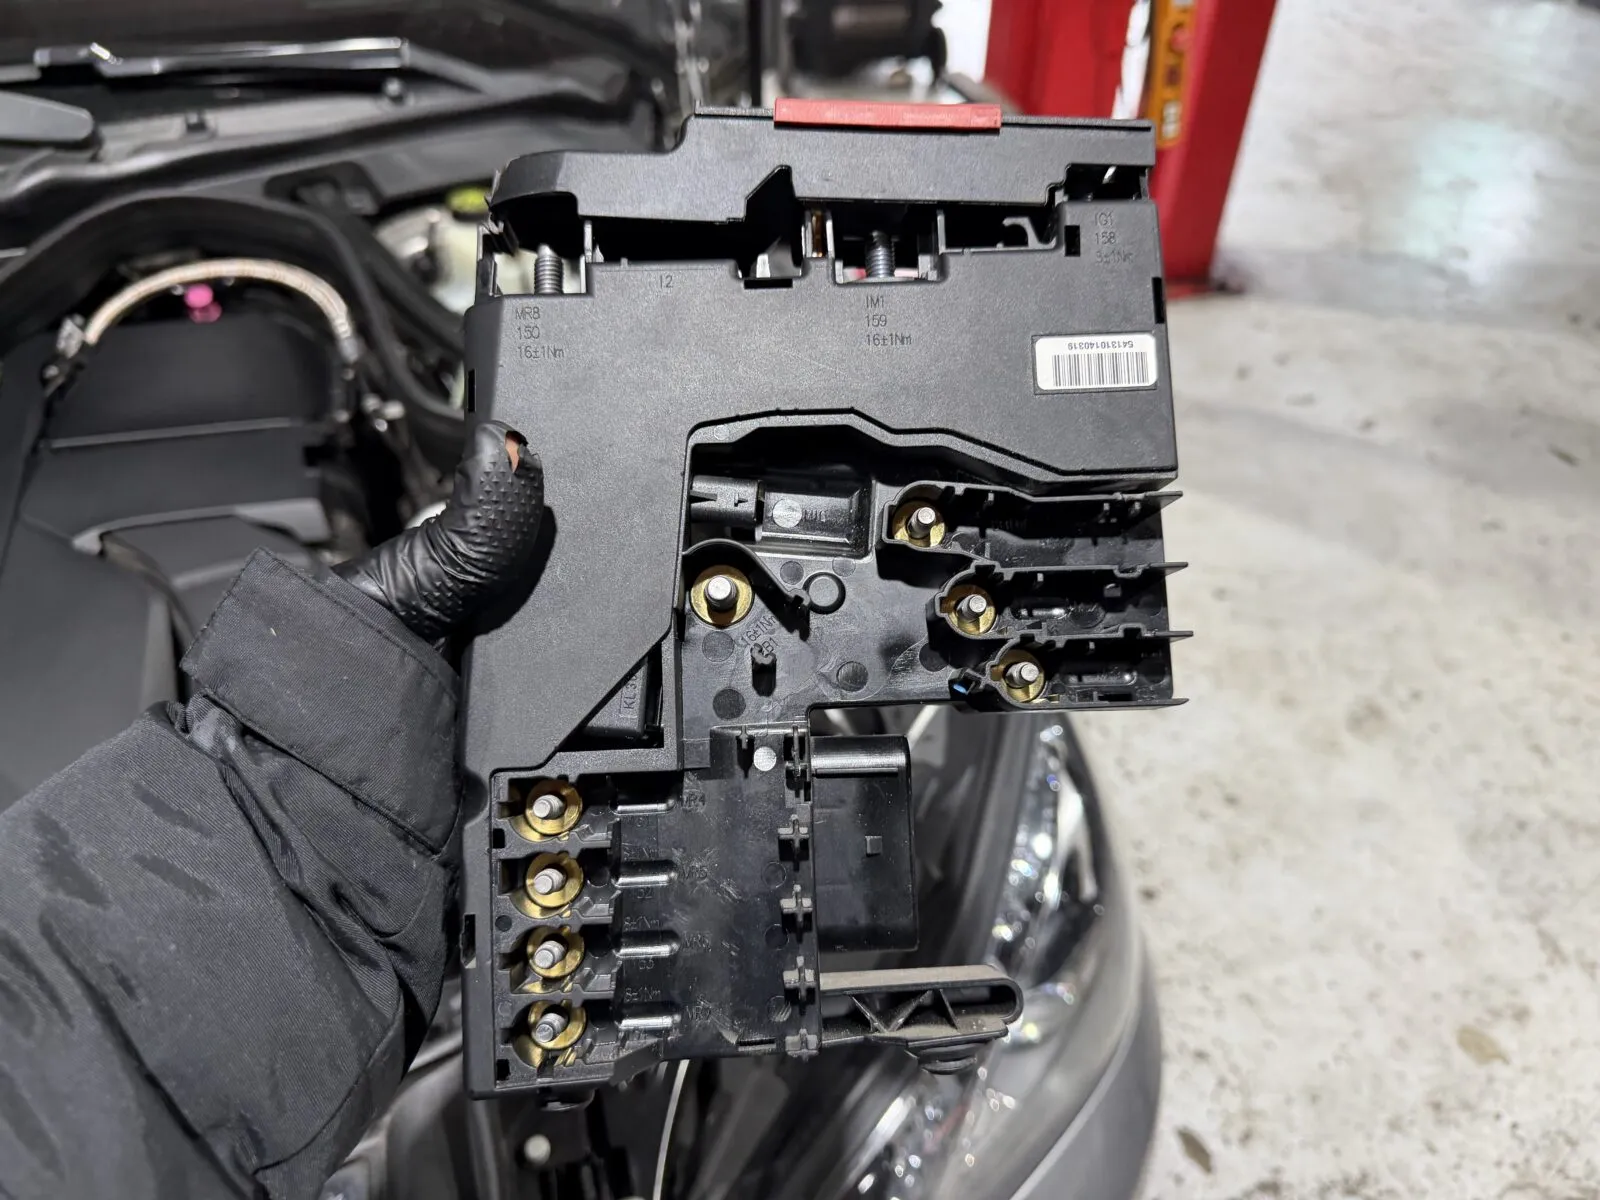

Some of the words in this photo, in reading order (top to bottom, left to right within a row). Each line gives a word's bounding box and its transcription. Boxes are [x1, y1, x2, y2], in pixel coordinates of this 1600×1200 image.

[865, 313, 887, 327] 159
[516, 325, 541, 340] 150
[1067, 340, 1134, 351] 541310140319
